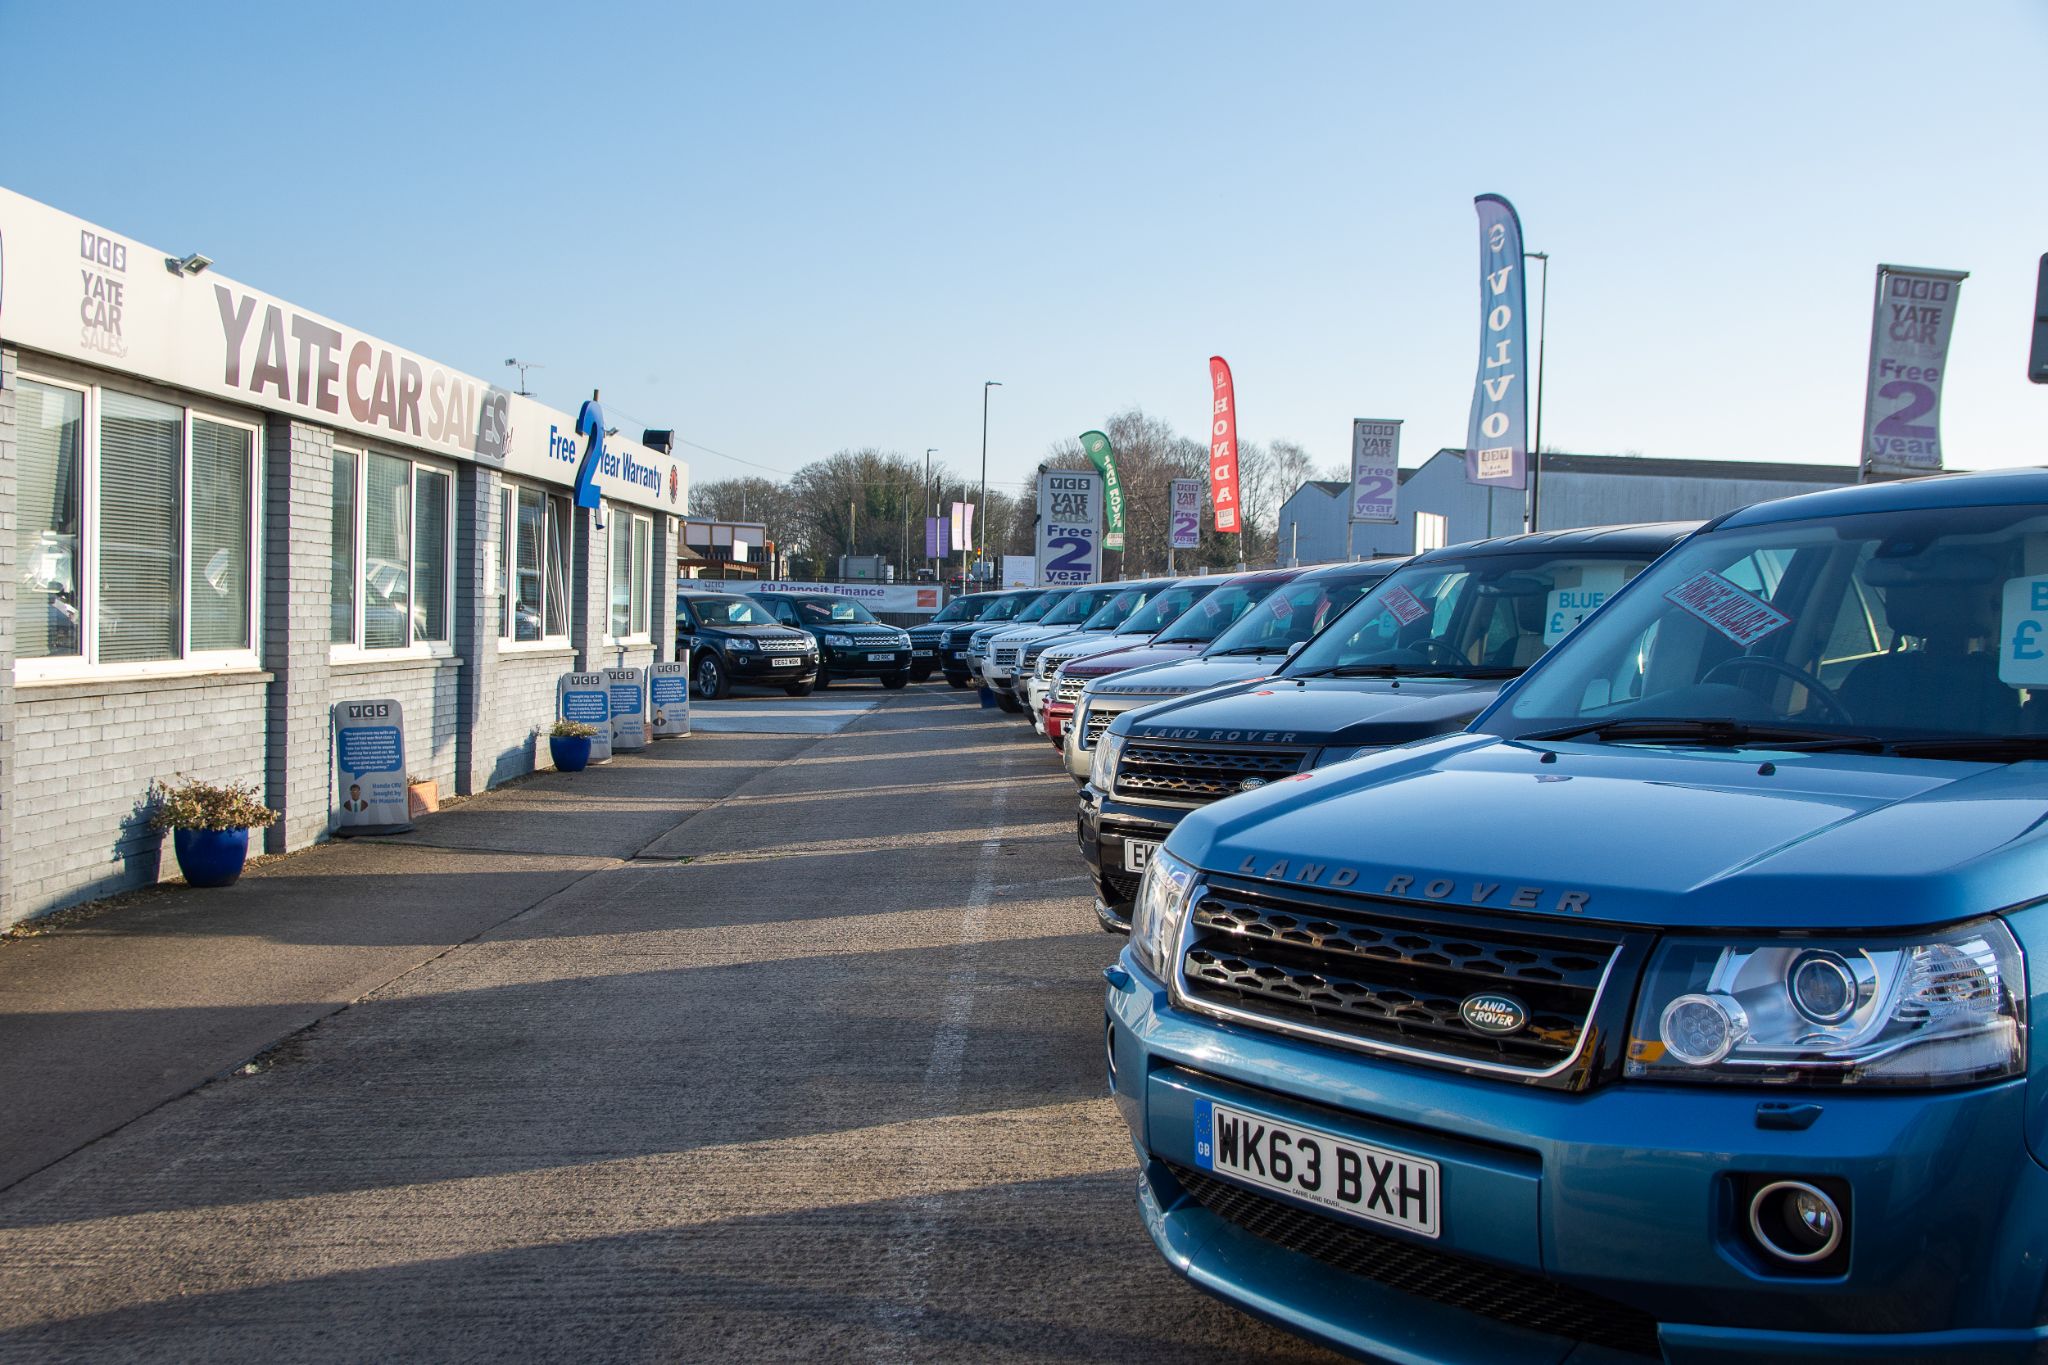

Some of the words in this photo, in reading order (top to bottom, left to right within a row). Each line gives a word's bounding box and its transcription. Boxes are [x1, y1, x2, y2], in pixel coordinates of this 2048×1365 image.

[82, 231, 126, 271] YCS
[81, 269, 123, 307] YATE
[81, 296, 121, 336] CAR
[1891, 304, 1942, 325] YATE
[1888, 319, 1937, 345] CAR
[213, 283, 342, 415] YATE
[346, 340, 423, 437] CAR
[427, 367, 508, 460] SALES
[1880, 358, 1939, 382] Free
[1872, 380, 1936, 439] 2
[1362, 438, 1393, 448] YATE
[1362, 447, 1390, 457] CAR
[1873, 436, 1936, 456] year
[549, 424, 575, 464] Free
[574, 400, 605, 509] 2
[600, 444, 620, 478] Year
[622, 452, 661, 498] Warranty
[1358, 466, 1394, 476] Free
[1051, 479, 1090, 489] YCS
[1356, 476, 1393, 505] 2
[1051, 493, 1089, 504] YATE
[1051, 503, 1088, 517] CAR
[1356, 504, 1392, 514] year
[1047, 525, 1092, 537] Free
[1174, 518, 1197, 537] 2
[1046, 537, 1092, 571] 2
[1045, 571, 1091, 582] year
[760, 583, 776, 592] £0
[834, 585, 885, 597] Finance
[1559, 591, 1604, 608] BLUE
[1550, 611, 1564, 633] £
[2012, 619, 2045, 660] £
[349, 705, 388, 718] YCS
[1143, 727, 1199, 739] LAND
[1210, 731, 1297, 743] ROVER
[1238, 854, 1359, 887] LAND
[1384, 873, 1592, 913] ROVER
[1475, 1000, 1506, 1013] LAND
[1475, 1011, 1514, 1027] ROVER
[1197, 1141, 1210, 1157] GB
[1217, 1112, 1322, 1192] WK63
[1335, 1146, 1428, 1225] BXH
